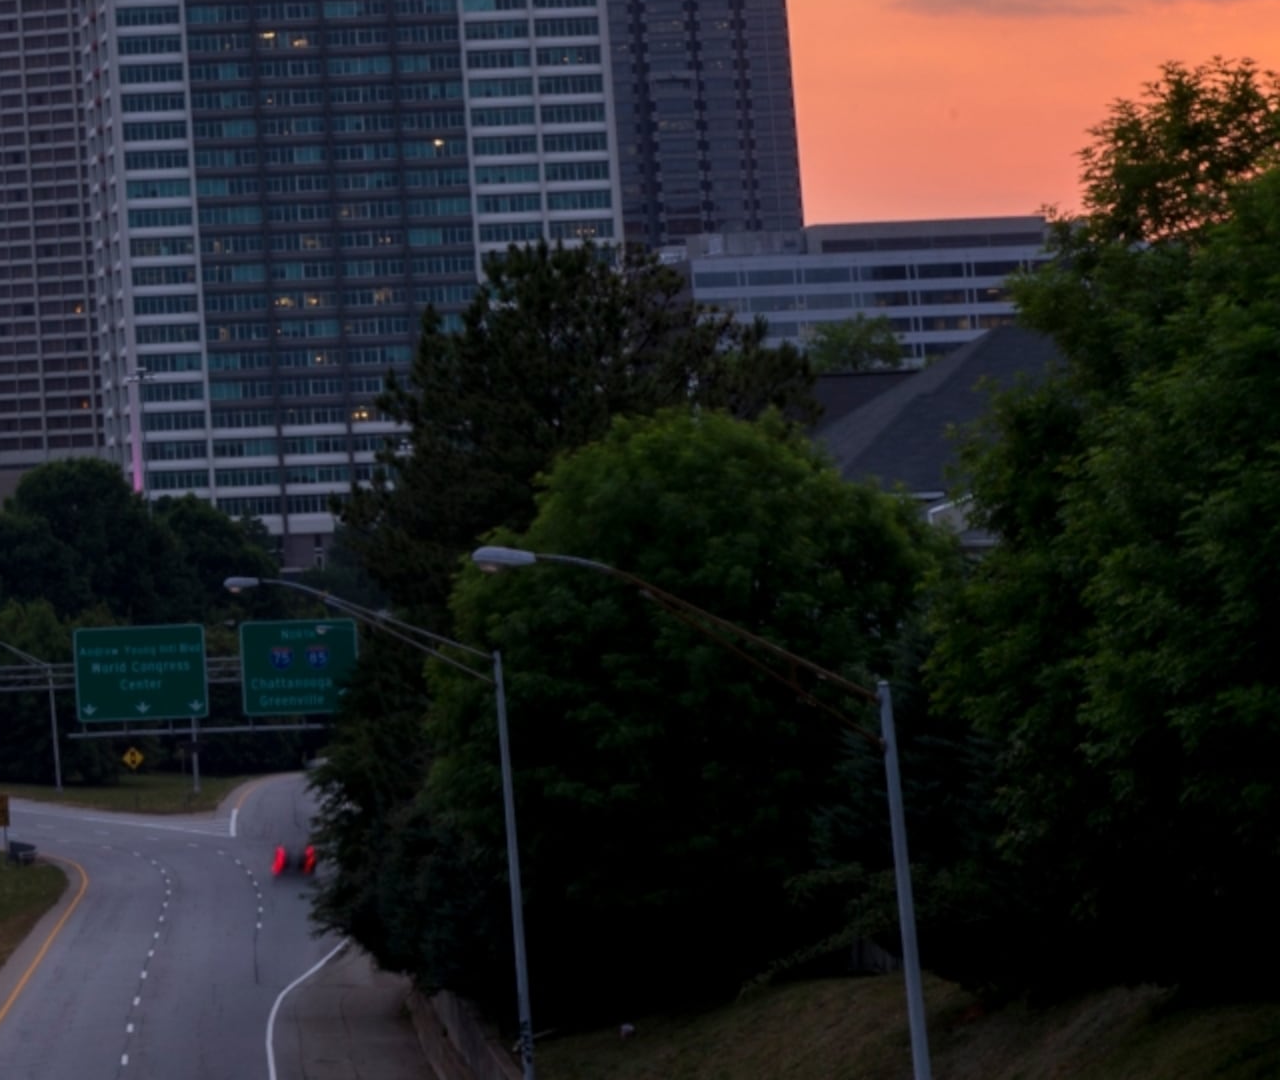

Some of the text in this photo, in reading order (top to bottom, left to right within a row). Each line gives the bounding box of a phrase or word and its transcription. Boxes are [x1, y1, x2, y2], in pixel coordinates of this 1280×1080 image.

[274, 652, 290, 664] 75
[91, 660, 190, 675] World Congress
[120, 678, 162, 691] Center
[259, 695, 325, 707] Greenville
